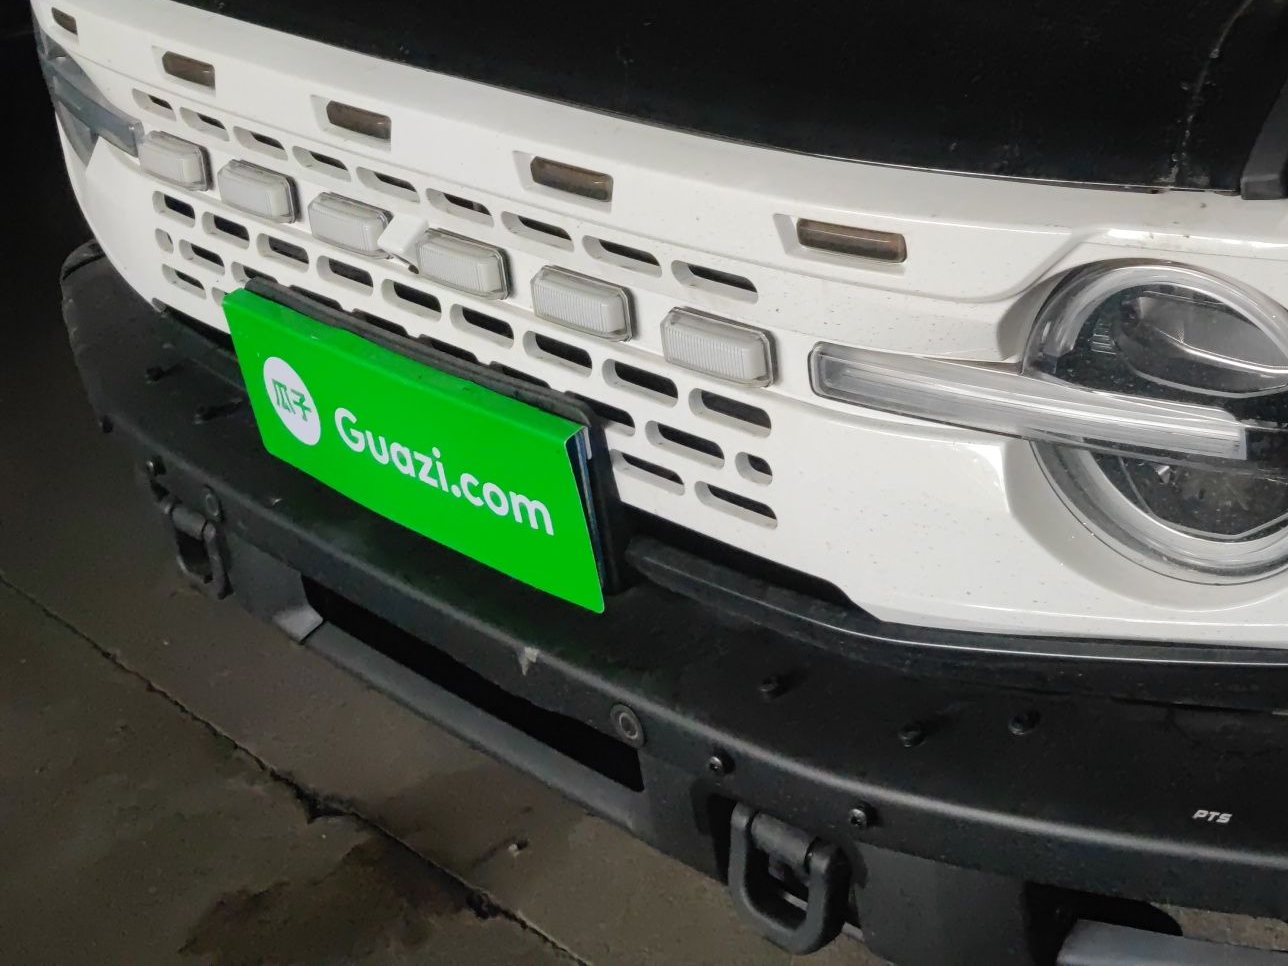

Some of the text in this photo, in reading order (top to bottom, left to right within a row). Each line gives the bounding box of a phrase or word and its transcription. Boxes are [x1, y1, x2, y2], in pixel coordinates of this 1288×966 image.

[272, 378, 313, 422] 瓜子
[334, 407, 554, 536] Guazi.com
[1192, 809, 1233, 824] PTS
